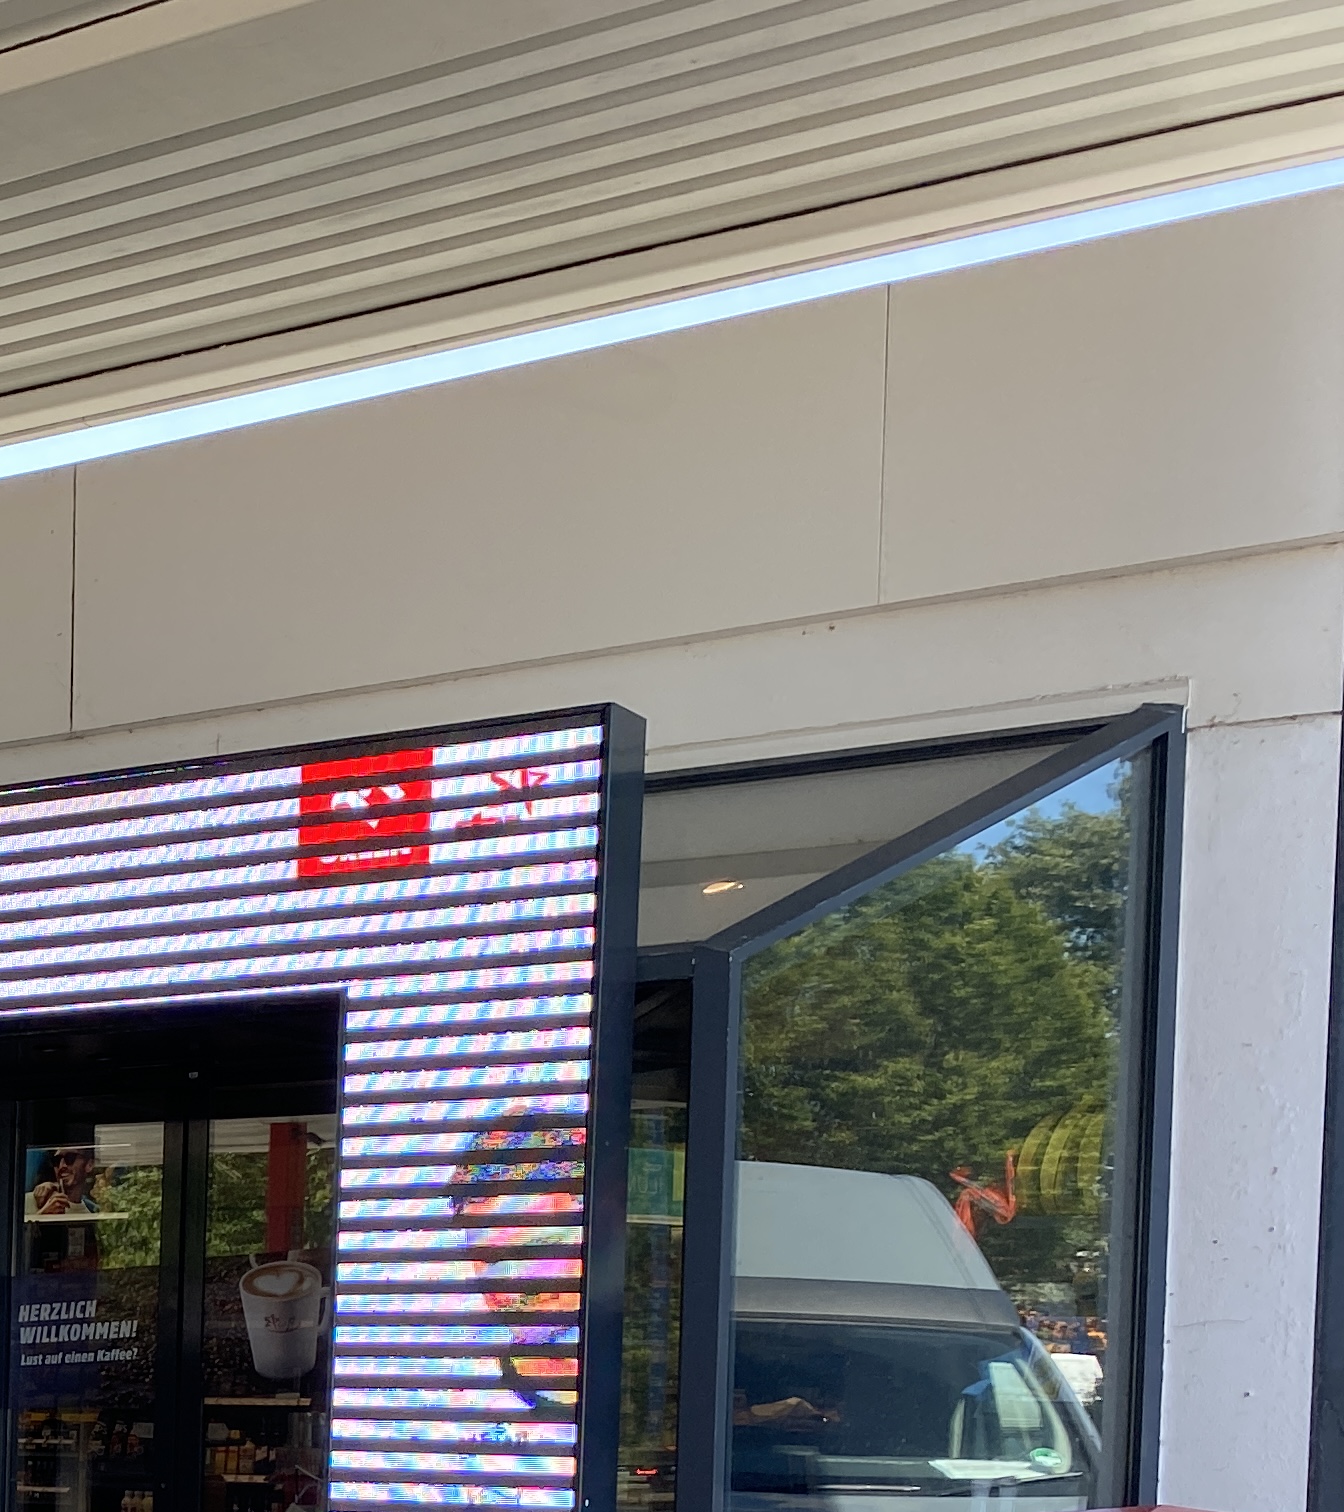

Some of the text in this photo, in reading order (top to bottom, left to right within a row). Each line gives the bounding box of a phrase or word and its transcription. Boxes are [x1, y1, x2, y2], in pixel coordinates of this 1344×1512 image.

[18, 1300, 97, 1322] HERZLICH
[20, 1320, 138, 1345] WILLKOMMEN!
[20, 1348, 138, 1366] Lust auf einen Kaffee?
